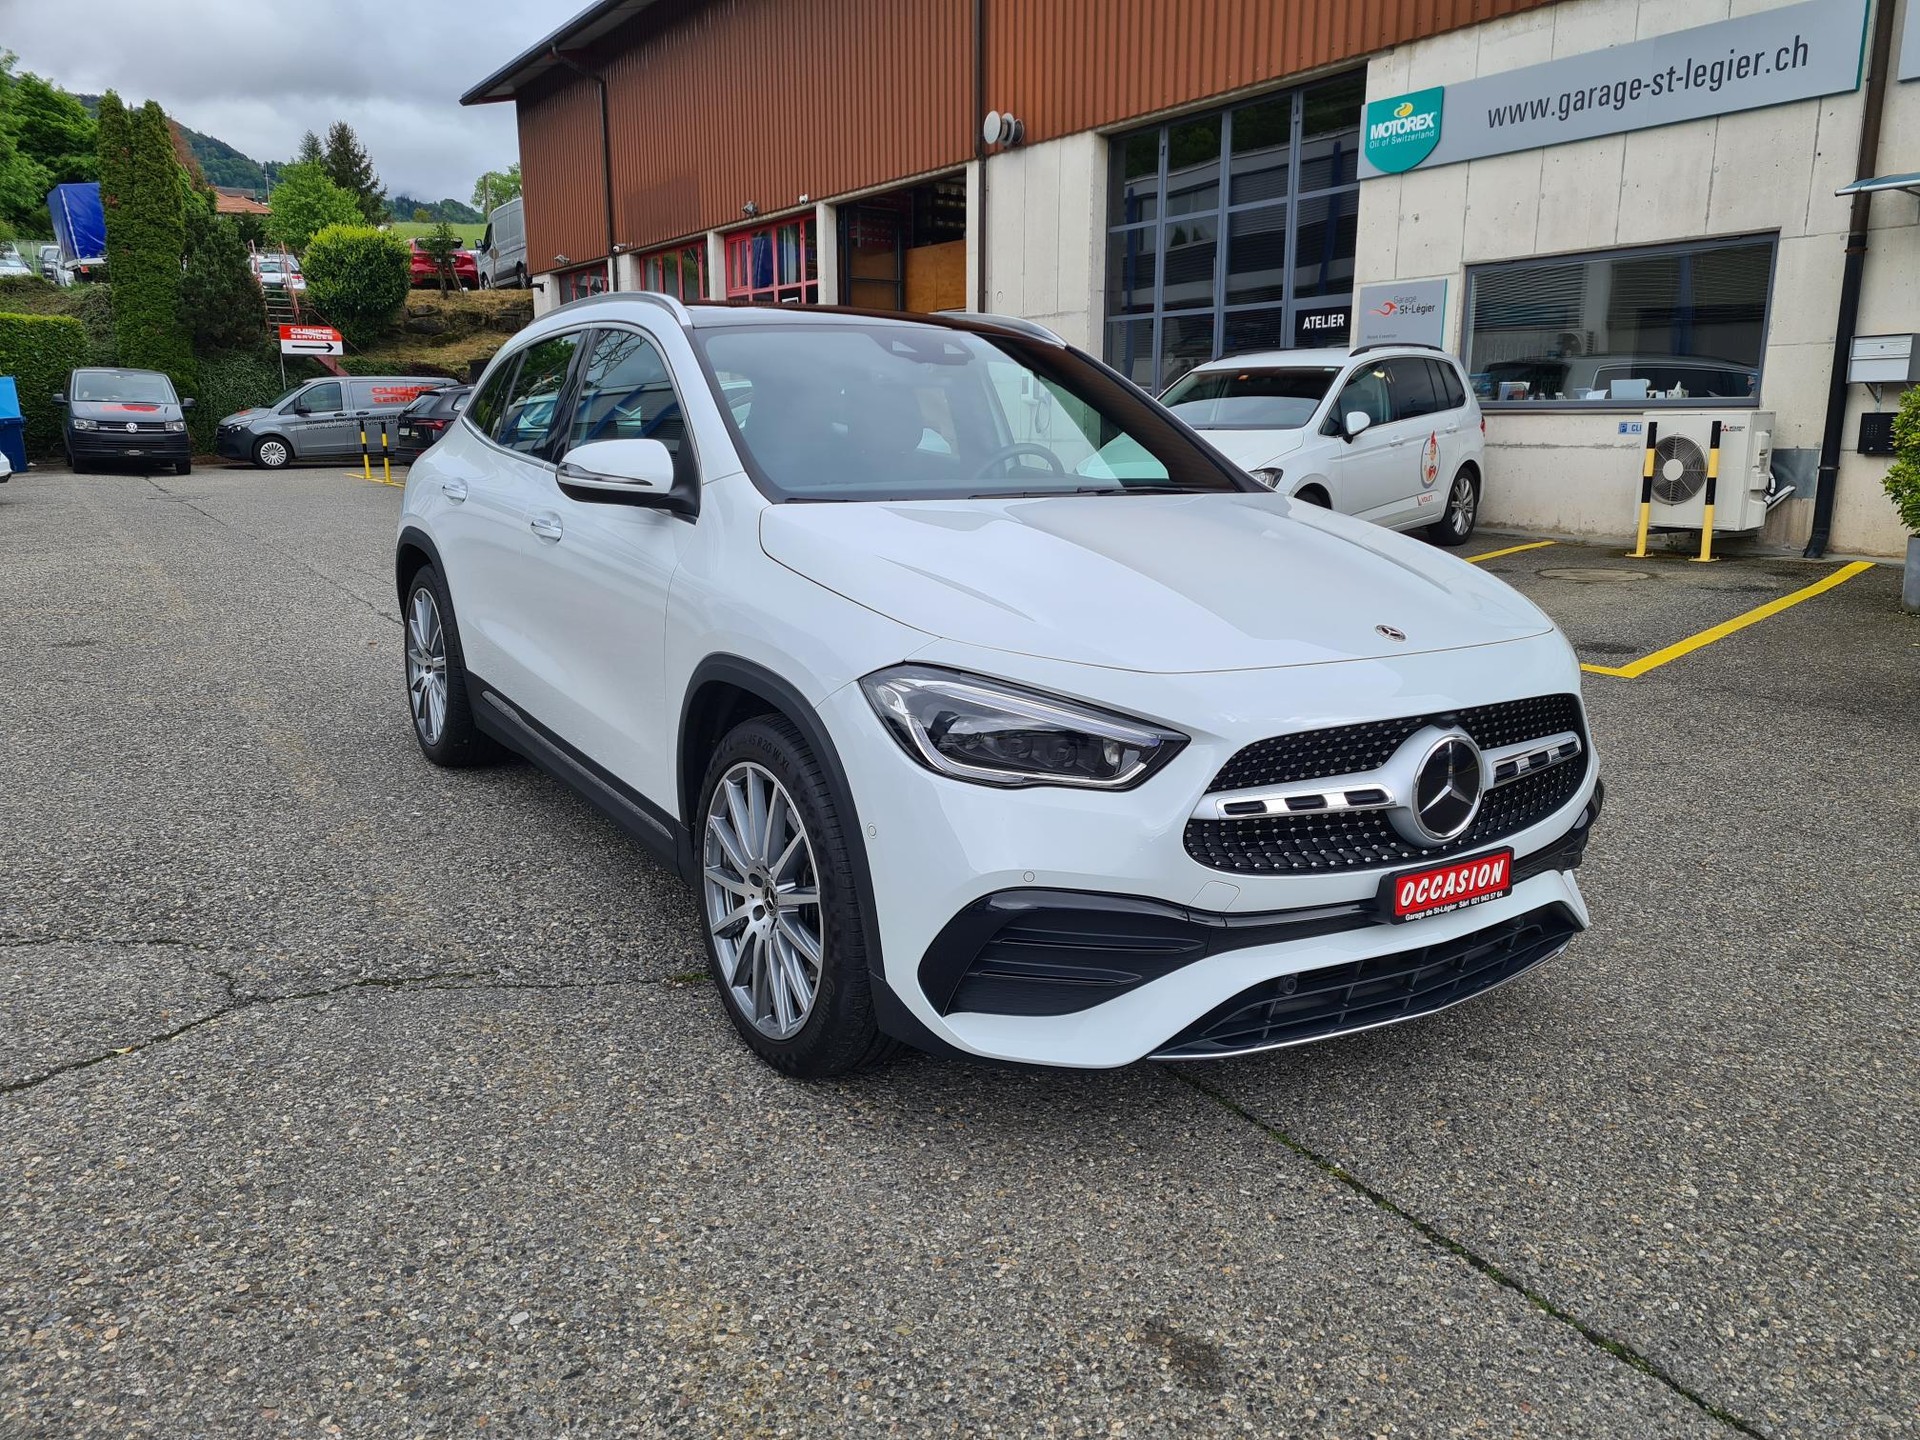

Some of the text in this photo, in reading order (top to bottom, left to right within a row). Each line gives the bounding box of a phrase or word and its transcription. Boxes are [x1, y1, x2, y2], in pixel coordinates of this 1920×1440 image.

[1487, 35, 1809, 128] www.garage-st-legier.ch
[1370, 112, 1434, 140] MOTOREX
[1369, 130, 1435, 149] Oil of Switzerland
[1393, 295, 1417, 304] Garage
[1399, 303, 1436, 316] St-Légier
[1302, 313, 1345, 330] ATELIER
[373, 396, 412, 404] SERVI
[1401, 859, 1505, 907] OCCASION
[1405, 911, 1425, 921] Garage
[1433, 903, 1458, 914] St-Légier
[1471, 897, 1480, 905] 021
[1480, 894, 1490, 902] 943
[1490, 892, 1496, 900] 57
